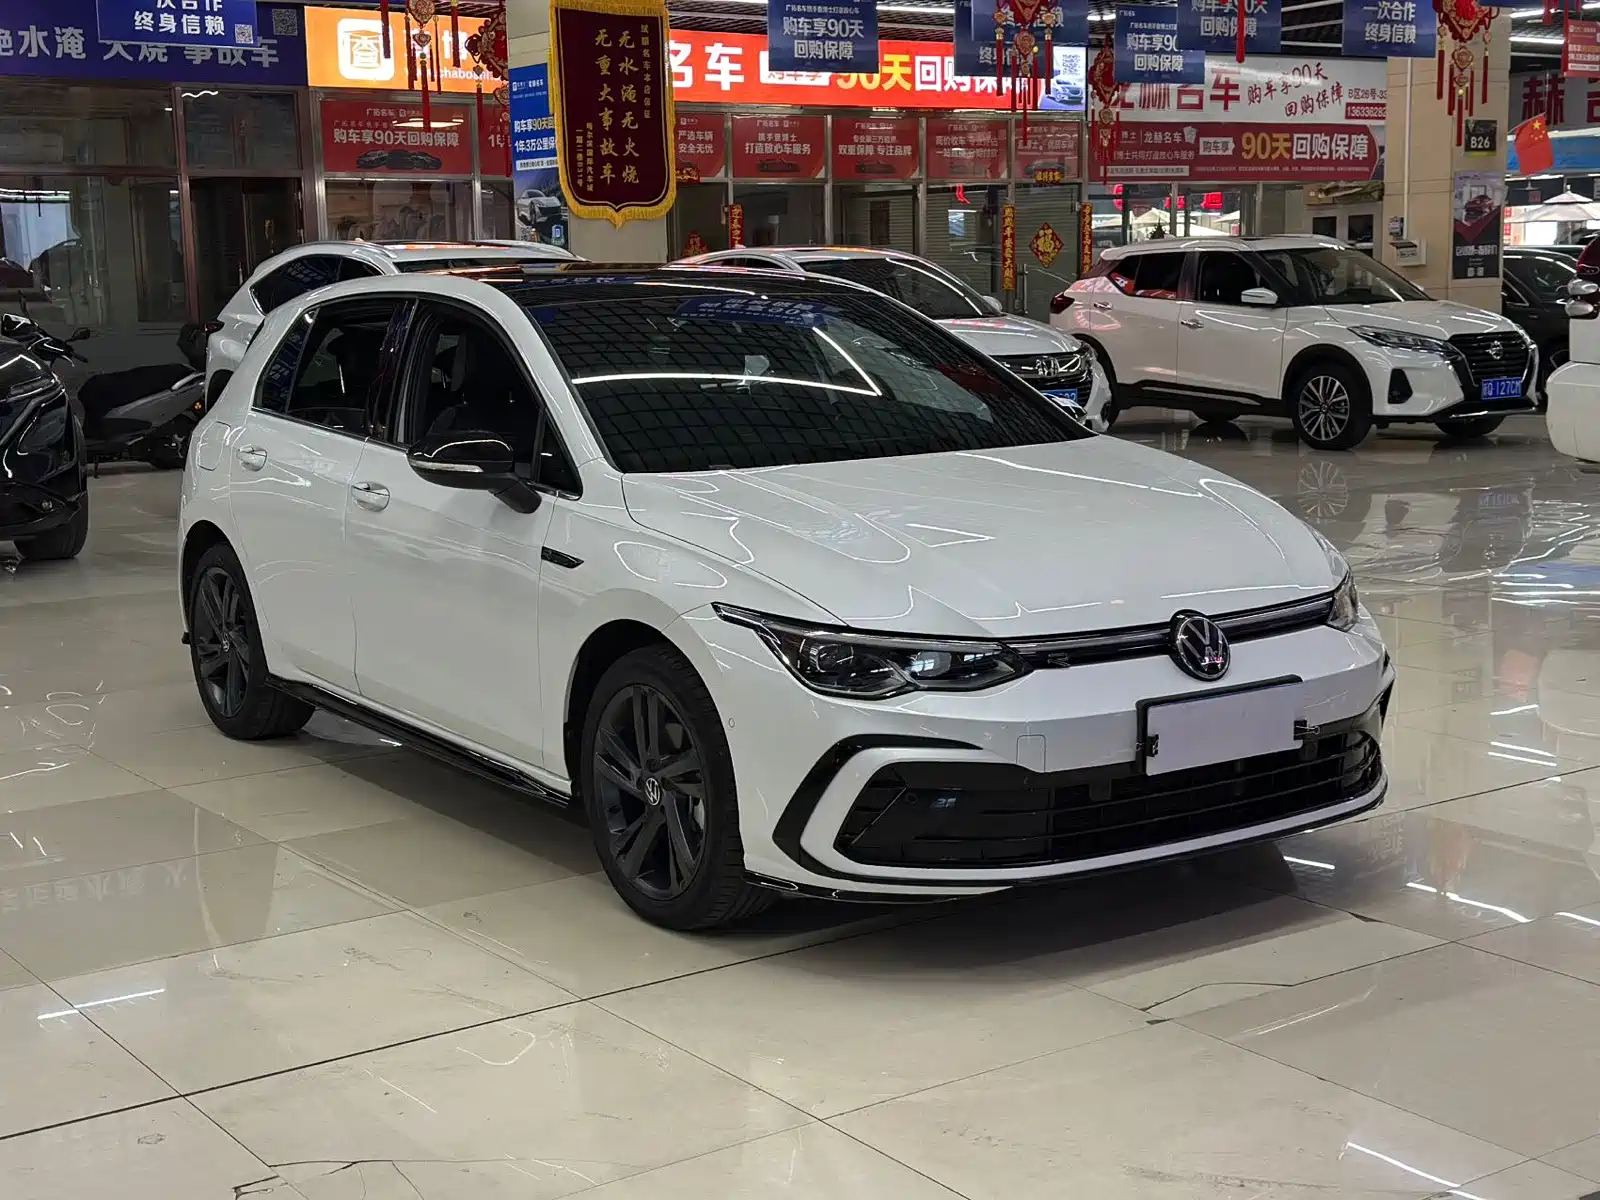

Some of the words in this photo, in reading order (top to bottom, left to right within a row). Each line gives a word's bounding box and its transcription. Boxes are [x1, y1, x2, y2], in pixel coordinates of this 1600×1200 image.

[1363, 1, 1417, 21] 一次合作
[134, 11, 225, 36] 终身信赖
[783, 16, 864, 38] 购车享90天
[1364, 22, 1417, 44] 终身信赖
[794, 39, 854, 60] 回购保障
[1134, 54, 1184, 71] 回购保障
[594, 28, 619, 185] 无重大事故车
[618, 30, 640, 184] 无水淹无火烧
[1285, 82, 1344, 117] 回购保障
[334, 128, 460, 147] 购车享90天回购保障
[1241, 132, 1369, 161] 90天回购保障
[1470, 136, 1491, 149] B26
